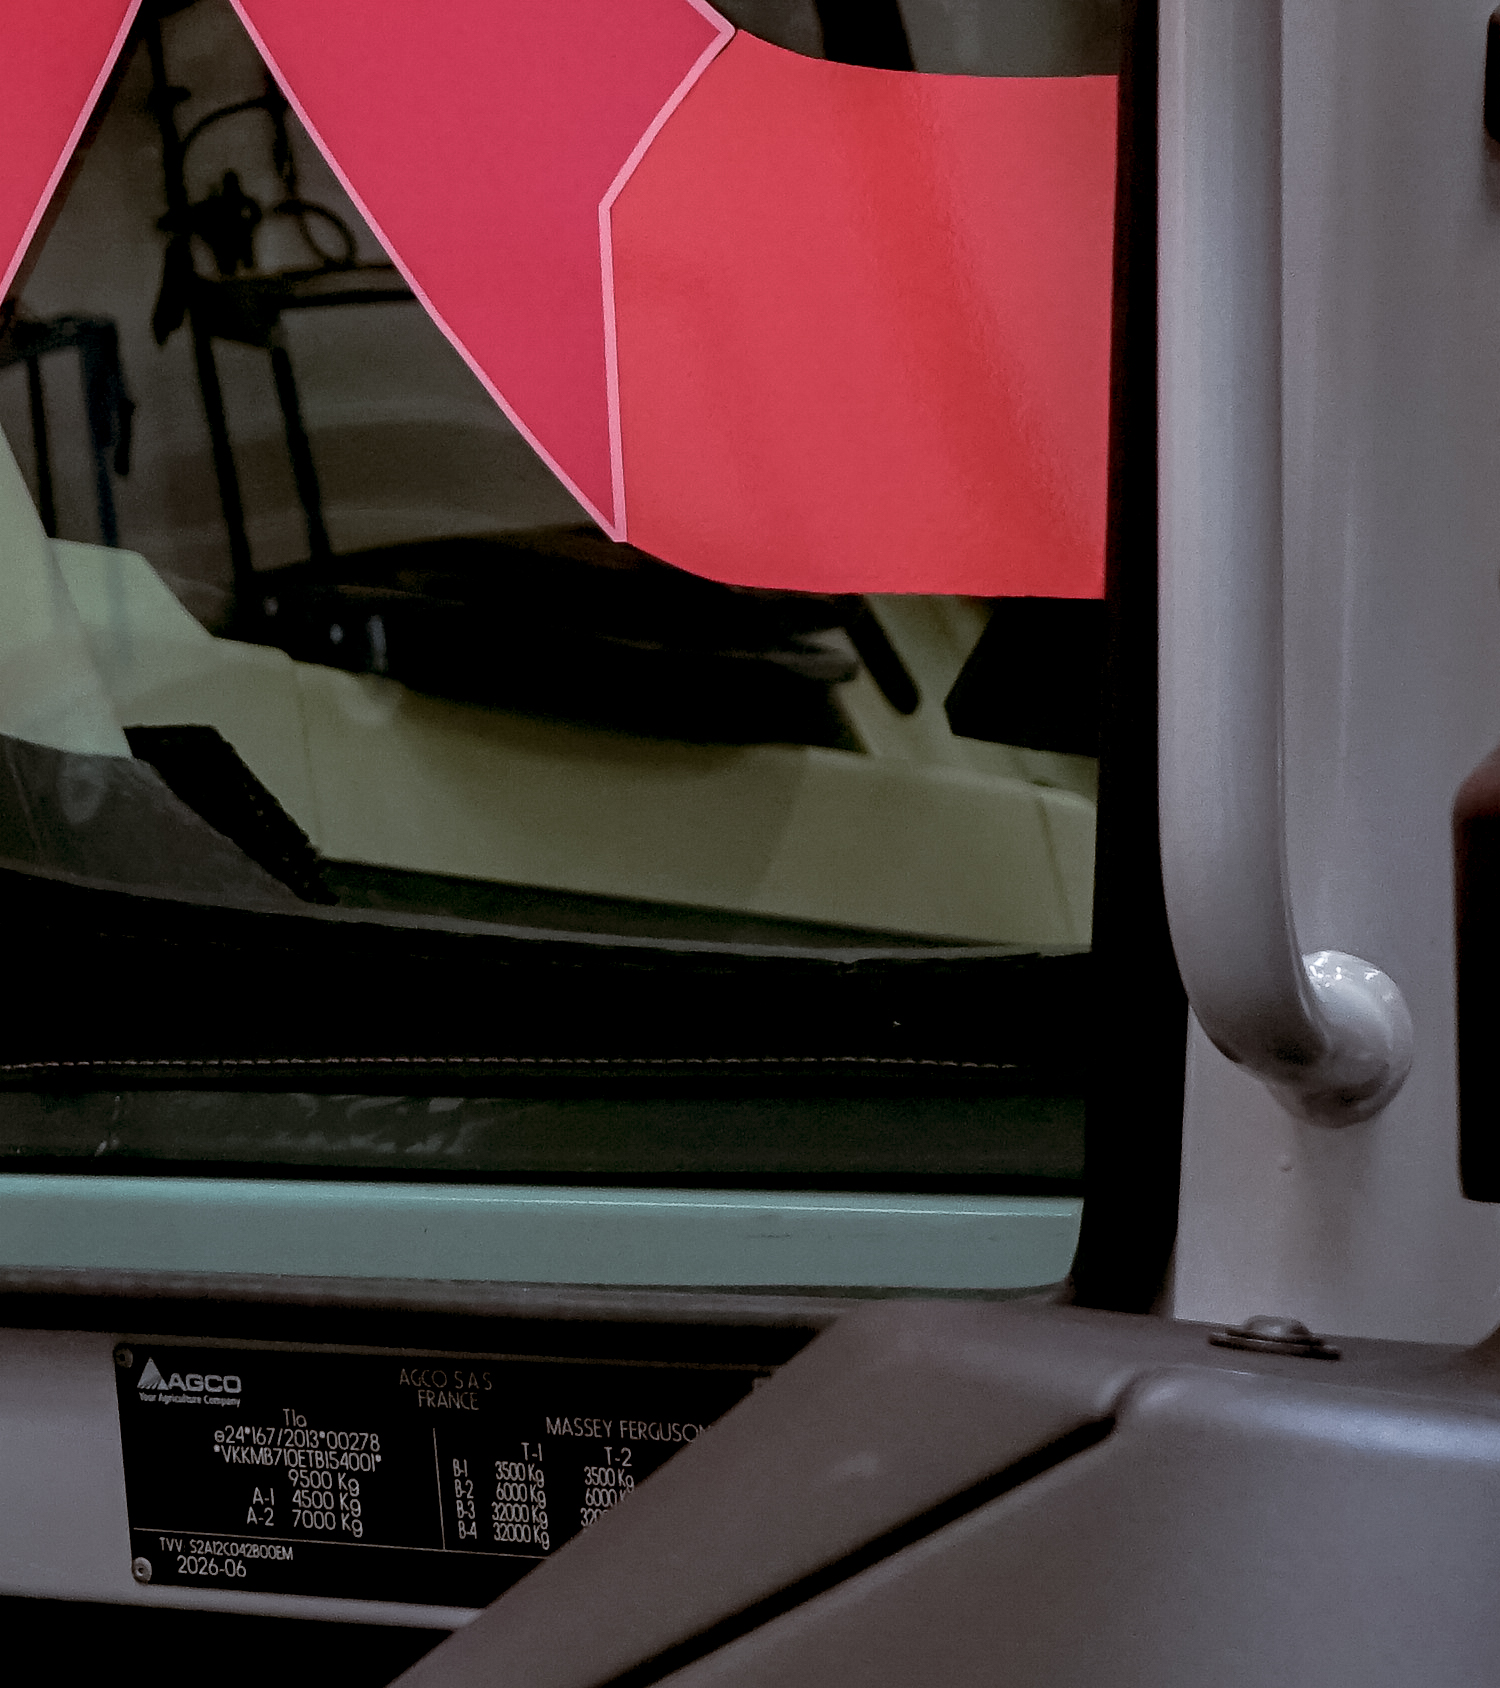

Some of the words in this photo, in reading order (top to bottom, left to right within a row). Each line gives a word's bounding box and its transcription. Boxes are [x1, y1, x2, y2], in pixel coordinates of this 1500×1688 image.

[168, 1372, 242, 1394] AGCO
[399, 1367, 448, 1389] AGCO
[416, 1388, 480, 1411] FRANCE
[545, 1416, 613, 1439] MASSEY
[603, 1445, 633, 1468] T-2
[287, 1468, 333, 1490] 9500
[337, 1471, 360, 1498] Kg
[494, 1460, 526, 1482] 3500
[527, 1462, 546, 1489] Kg
[583, 1465, 616, 1487] 3500
[617, 1467, 635, 1494] Kg
[291, 1488, 335, 1511] 4500
[338, 1491, 362, 1518] Kg
[453, 1478, 475, 1500] B-2
[495, 1481, 528, 1503] 6000
[529, 1484, 547, 1510] Kg
[584, 1486, 618, 1508] 6000
[246, 1505, 276, 1527] A-2
[291, 1508, 337, 1531] 7000
[340, 1512, 364, 1539] Kg
[455, 1499, 476, 1520] B-3
[490, 1500, 530, 1523] 32000
[531, 1504, 549, 1531] Kg
[457, 1519, 478, 1540] B-4
[492, 1521, 532, 1544] 32000
[533, 1524, 551, 1551] Kg
[176, 1554, 248, 1578] 2026-06
